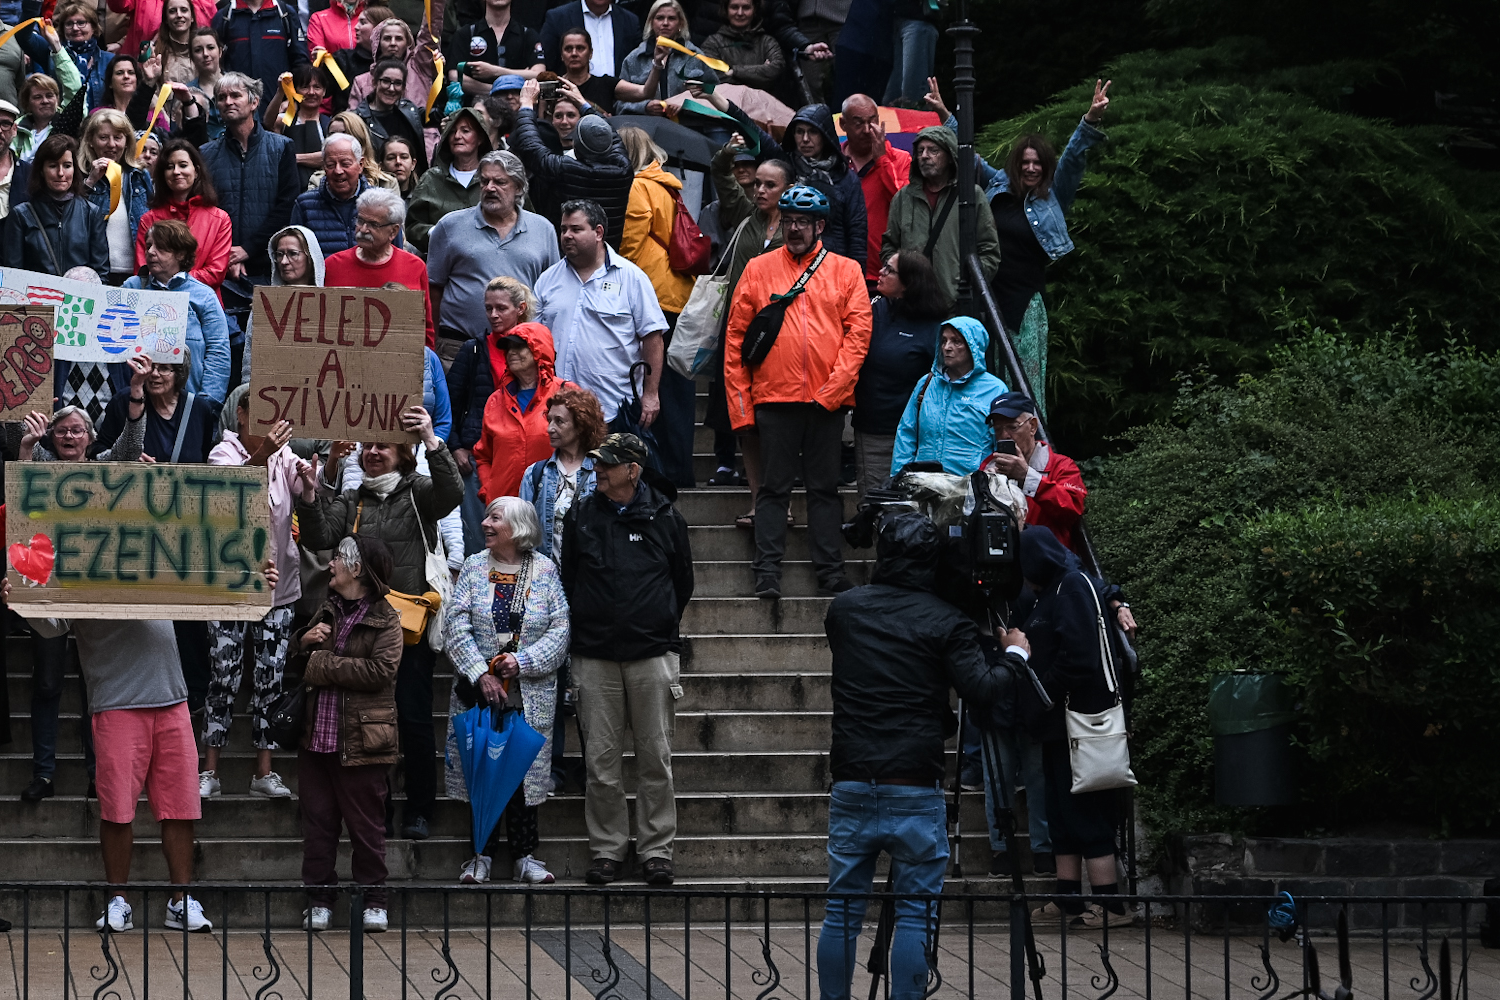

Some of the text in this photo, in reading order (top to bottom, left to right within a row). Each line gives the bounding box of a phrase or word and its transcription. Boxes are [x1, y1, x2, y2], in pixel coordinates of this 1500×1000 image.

[260, 291, 392, 347] VELED
[316, 349, 345, 389] A
[257, 377, 409, 431] SZÍVÜNK
[21, 466, 263, 530] EGYÜTT
